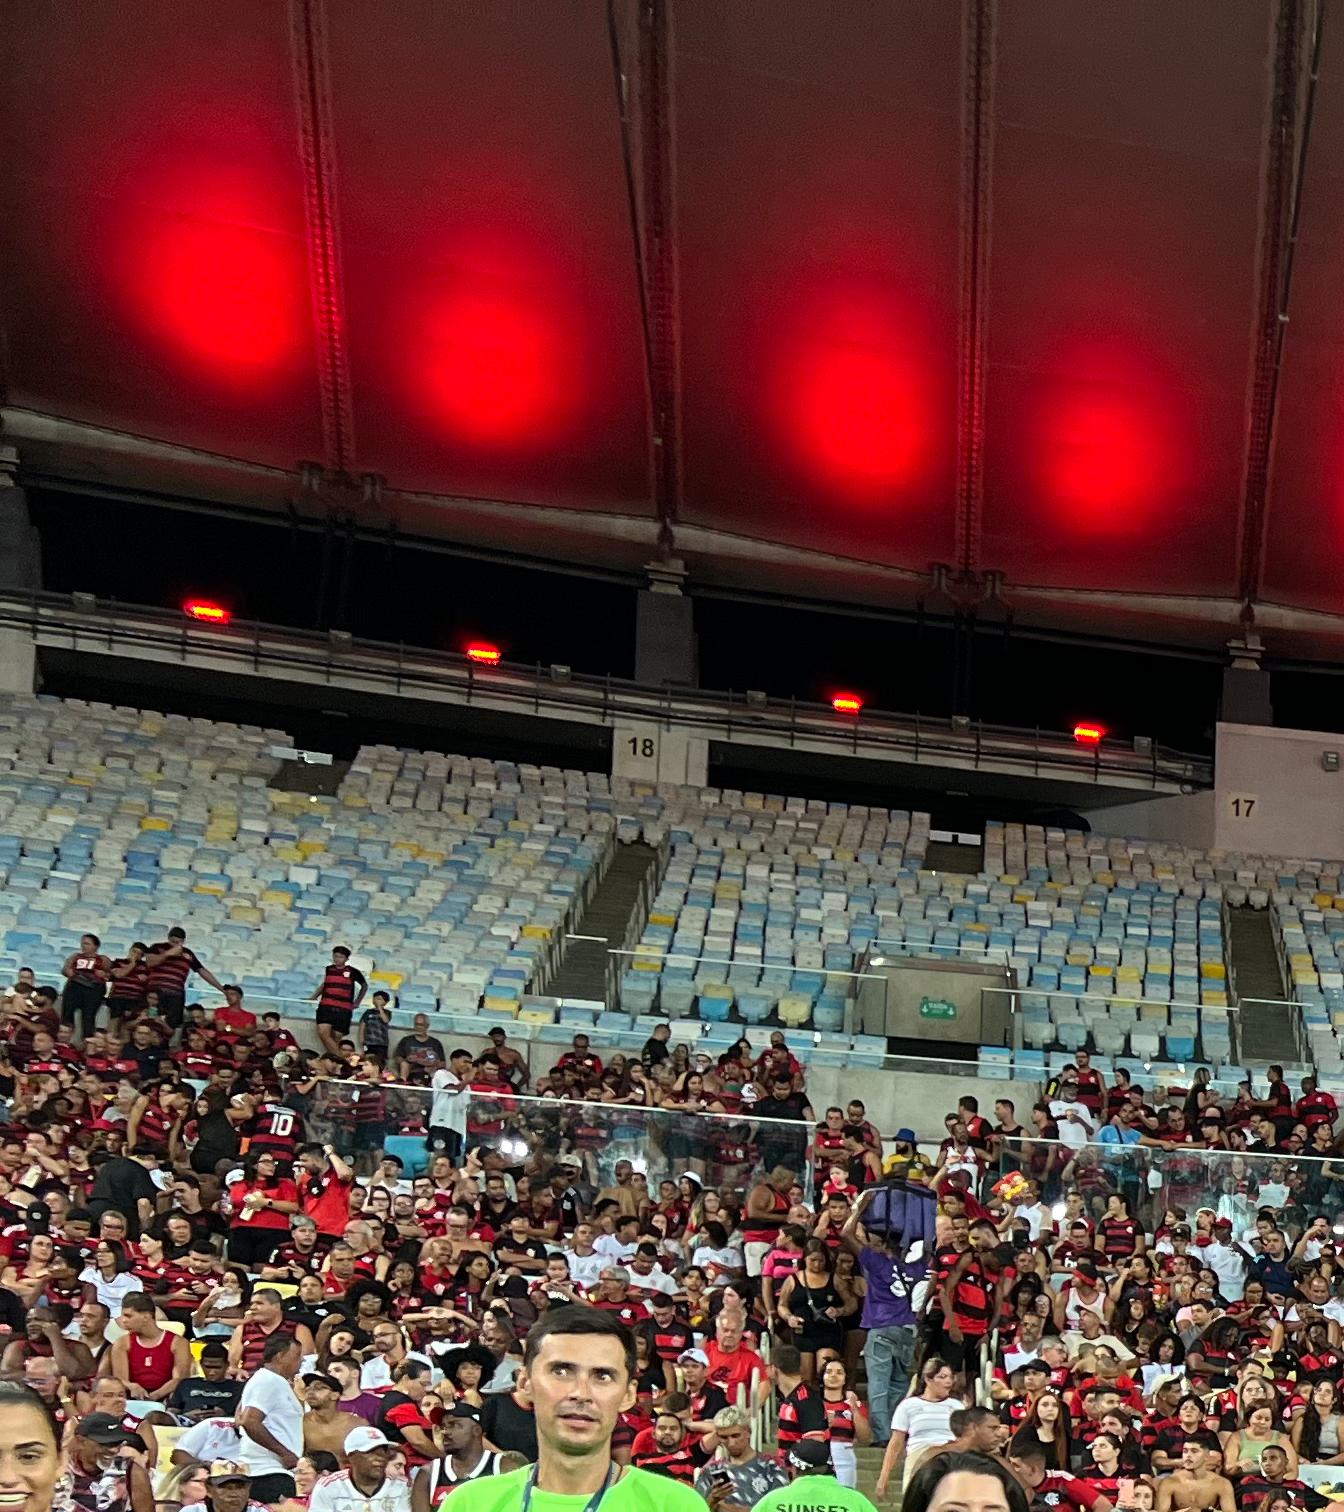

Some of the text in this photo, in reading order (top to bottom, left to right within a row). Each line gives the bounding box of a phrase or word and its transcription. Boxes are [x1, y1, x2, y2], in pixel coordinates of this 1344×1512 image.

[627, 736, 654, 758] 18
[1231, 798, 1256, 818] 17
[270, 1112, 294, 1137] 10
